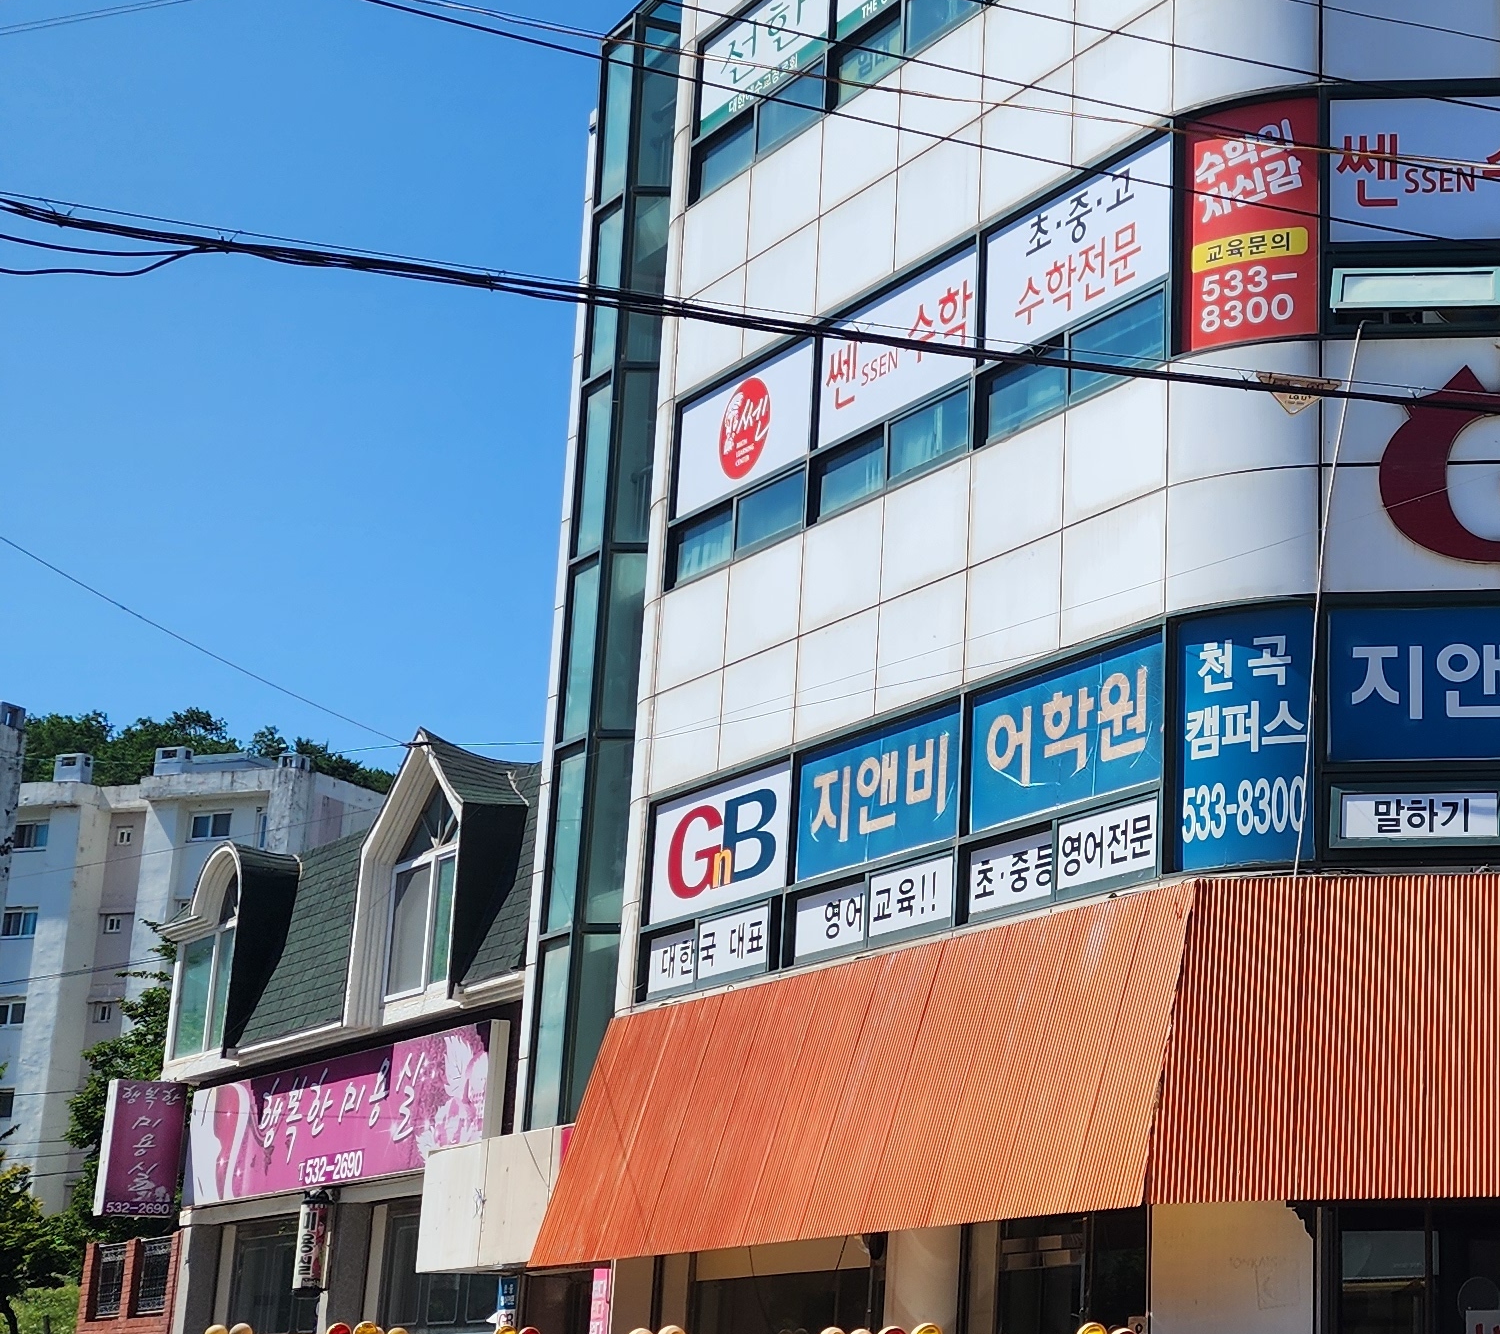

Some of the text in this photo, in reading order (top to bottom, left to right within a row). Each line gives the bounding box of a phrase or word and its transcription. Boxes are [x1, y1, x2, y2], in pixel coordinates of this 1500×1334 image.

[1197, 119, 1294, 185] 수학의
[1336, 134, 1397, 208] 쎈
[1405, 168, 1475, 194] SSEN
[1201, 157, 1302, 223] 자신감
[1014, 220, 1143, 327] 수학전문
[1205, 230, 1290, 263] 교육문의
[825, 278, 975, 410] 쎈 SSEN 수학
[1201, 292, 1294, 331] 8300
[811, 730, 950, 843] 지앤비
[985, 664, 1149, 788] 어학원
[1184, 698, 1307, 762] 캠퍼스
[1182, 774, 1305, 844] 533-8300
[1372, 796, 1471, 834] 말하기
[729, 920, 764, 960] 대표
[824, 892, 865, 940] 영어
[873, 871, 937, 923] 교육!!
[1060, 813, 1153, 878] 영어전문
[259, 1052, 425, 1165] 행복한 미용실
[305, 1151, 362, 1184] 532-2690
[106, 1202, 169, 1214] 532-2690
